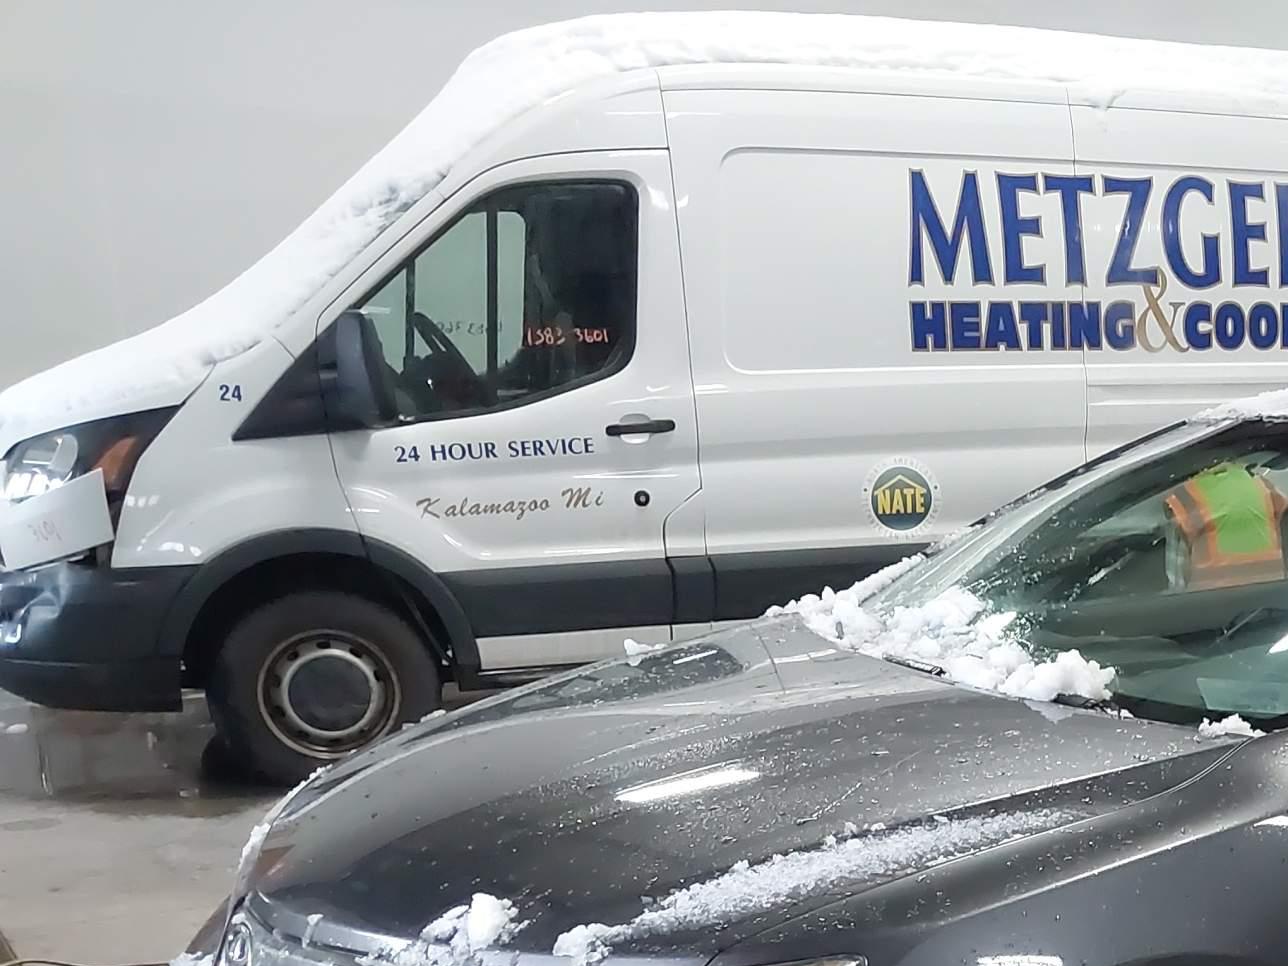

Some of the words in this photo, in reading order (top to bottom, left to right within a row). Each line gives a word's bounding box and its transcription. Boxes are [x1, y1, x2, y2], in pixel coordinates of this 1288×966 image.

[909, 301, 1137, 352] HEATING
[1136, 266, 1190, 353] &
[219, 384, 242, 402] 24
[394, 446, 420, 462] 24
[431, 442, 498, 461] HOUR
[508, 437, 595, 458] SERVICE
[416, 497, 550, 520] Kalamazoo
[561, 487, 605, 509] Mi
[877, 486, 926, 515] NATE
